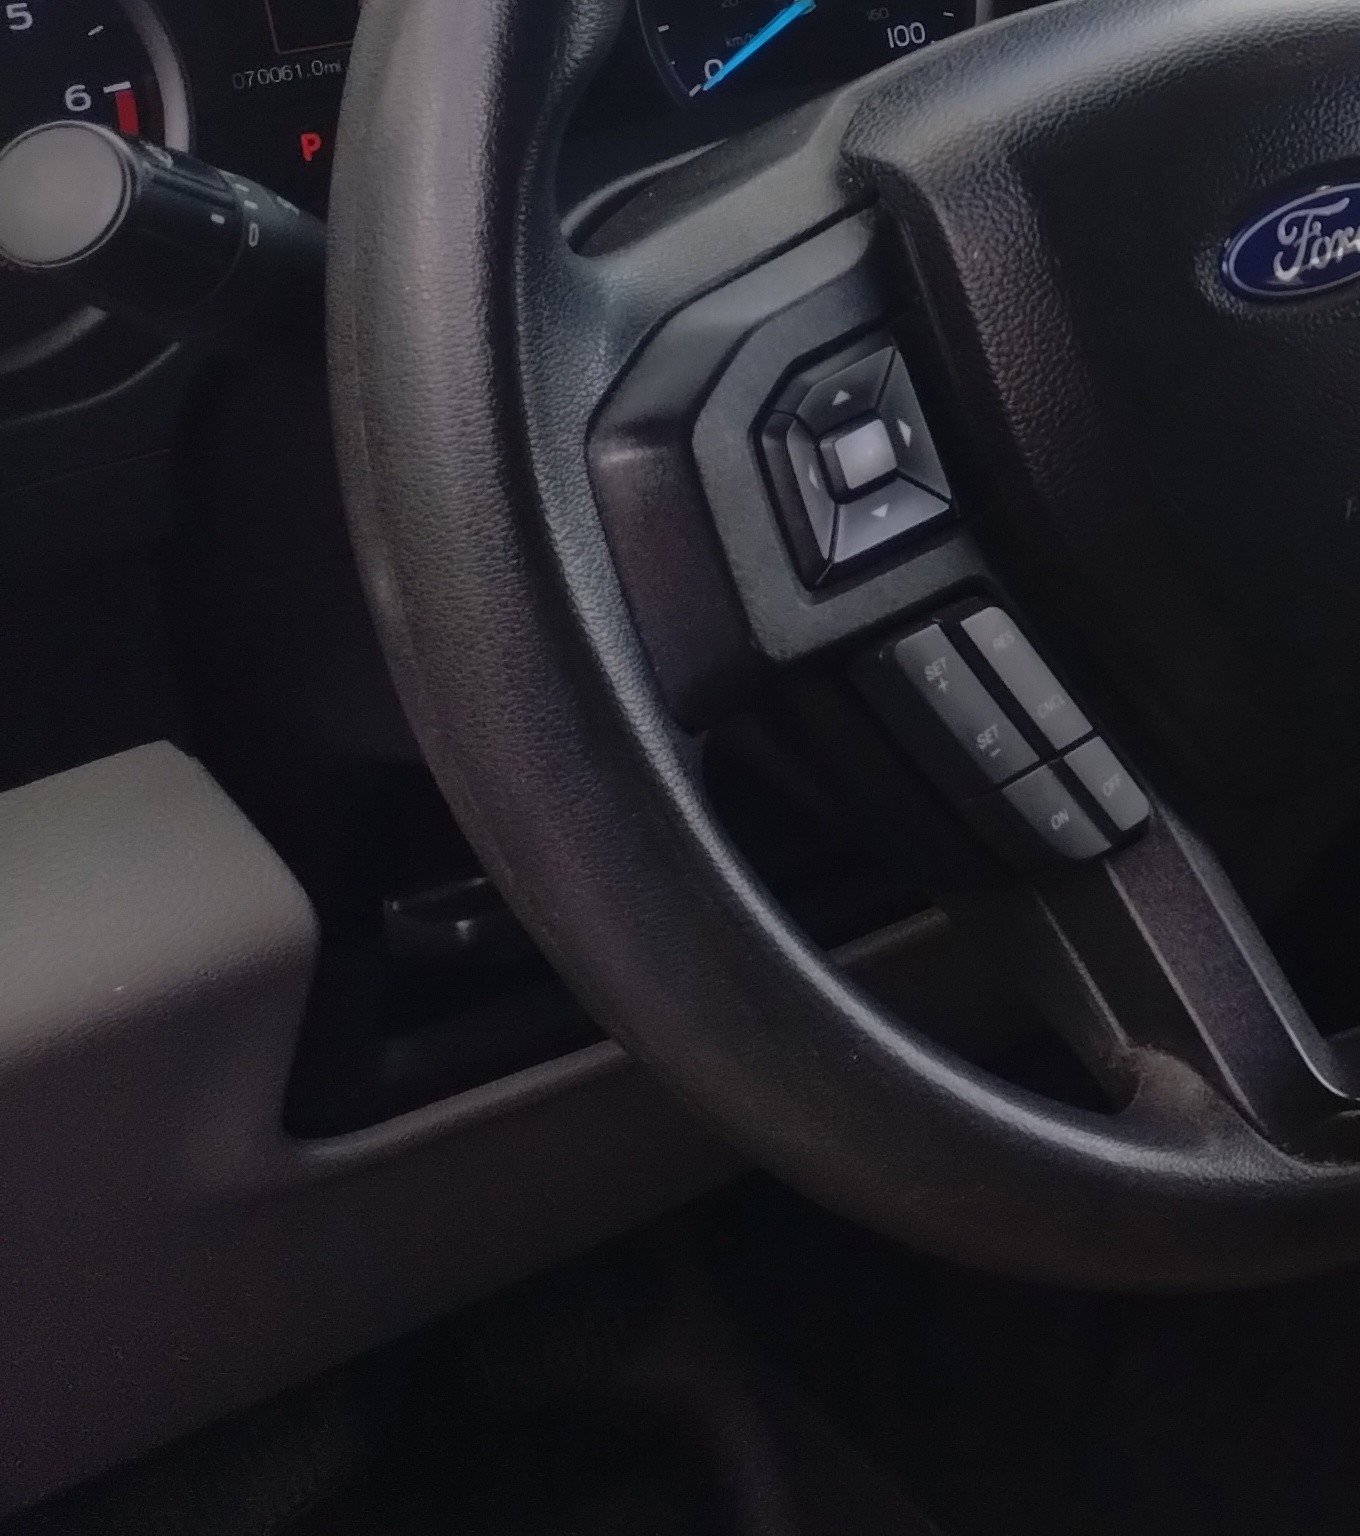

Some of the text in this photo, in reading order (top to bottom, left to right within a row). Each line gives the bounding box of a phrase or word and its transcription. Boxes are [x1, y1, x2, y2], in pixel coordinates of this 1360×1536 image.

[5, 2, 33, 31] 5
[886, 20, 926, 49] 100
[64, 84, 92, 112] 6
[924, 656, 948, 682] SET
[976, 724, 1000, 751] SET
[1050, 809, 1071, 831] ON
